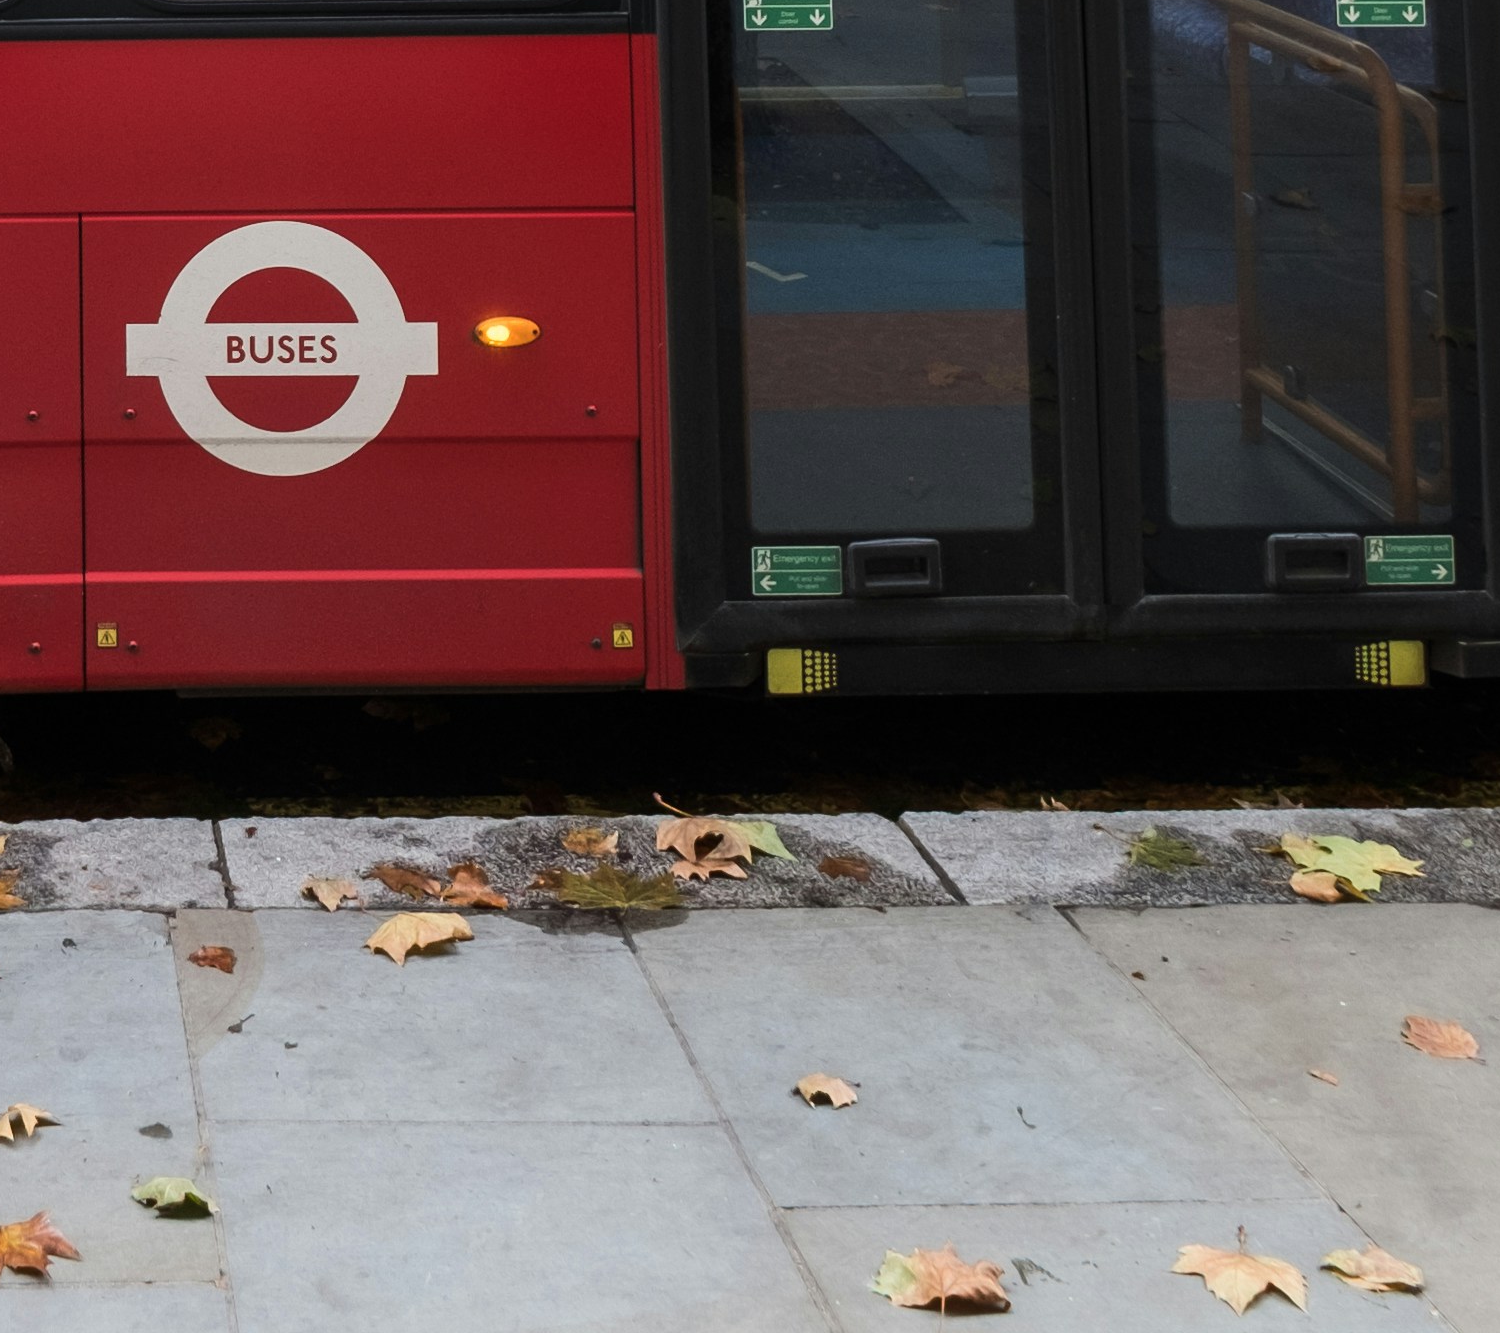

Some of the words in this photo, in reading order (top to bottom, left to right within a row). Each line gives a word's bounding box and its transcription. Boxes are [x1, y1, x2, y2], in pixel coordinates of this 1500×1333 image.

[226, 336, 339, 364] BUSES
[1385, 543, 1432, 554] Emergency
[772, 554, 819, 564] Emergency
